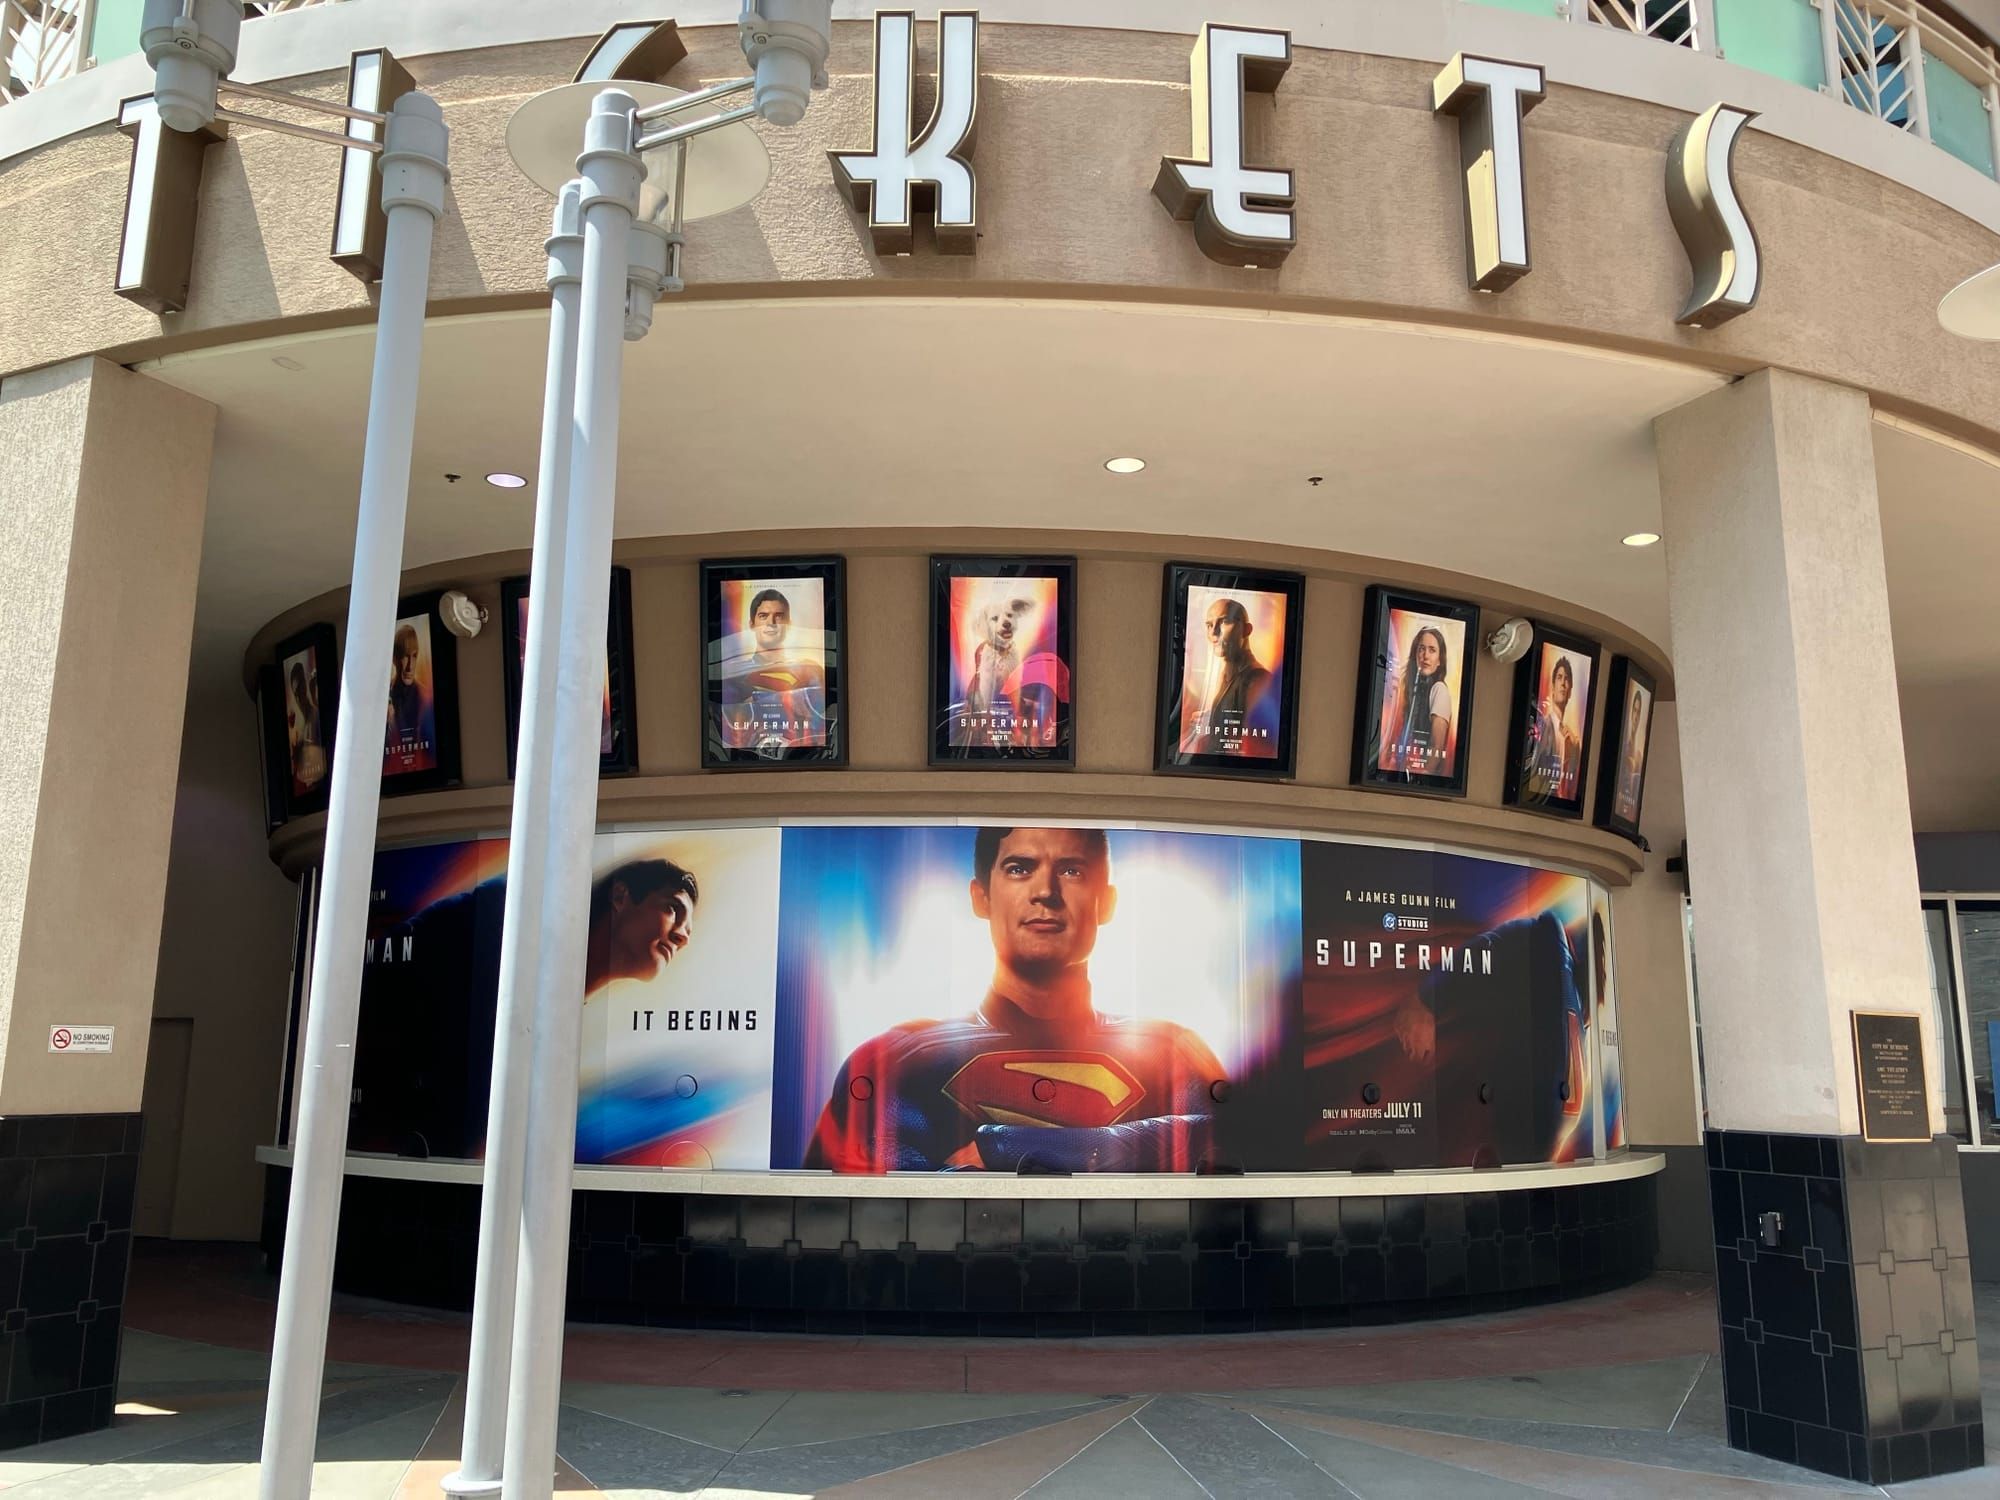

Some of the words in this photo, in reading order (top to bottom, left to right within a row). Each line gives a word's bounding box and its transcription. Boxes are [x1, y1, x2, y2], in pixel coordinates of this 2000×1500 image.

[115, 9, 1762, 326] TIKETS
[733, 721, 810, 731] SUPERMAN
[960, 718, 1039, 728] SUPERMAN
[1195, 725, 1267, 738] SUPERMAN
[1345, 889, 1352, 902] A
[1358, 891, 1396, 905] JAMES
[1401, 894, 1430, 908] GUNN
[1435, 896, 1456, 910] FILM
[1398, 918, 1429, 929] STUDIOS
[1316, 938, 1493, 975] SUPERMAN
[633, 1010, 654, 1031] IT
[668, 1010, 757, 1031] BEGINS
[73, 1033, 82, 1041] NO
[83, 1033, 110, 1041] SMOKING
[1322, 1108, 1339, 1119] ONLY
[1340, 1108, 1348, 1119] IN
[1350, 1108, 1382, 1119] THEATERS
[1383, 1102, 1410, 1118] JULY
[1412, 1102, 1422, 1118] 11
